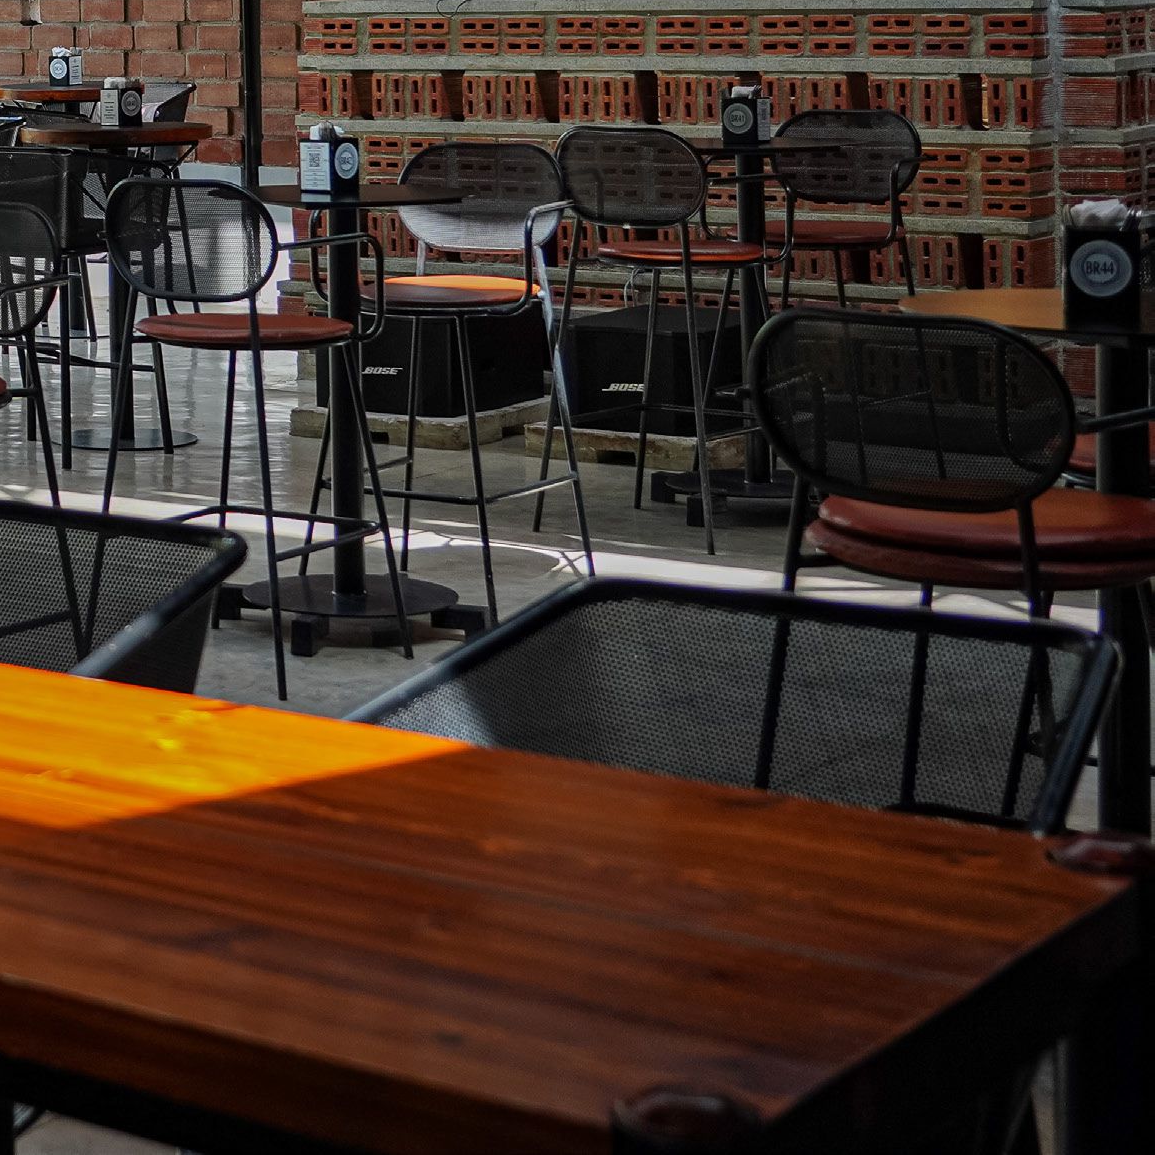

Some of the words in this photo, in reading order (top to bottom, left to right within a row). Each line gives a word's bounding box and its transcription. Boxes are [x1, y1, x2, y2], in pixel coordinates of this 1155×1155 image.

[1085, 260, 1115, 275] BR44
[361, 366, 403, 375] BOSE
[601, 383, 645, 392] BOSE
